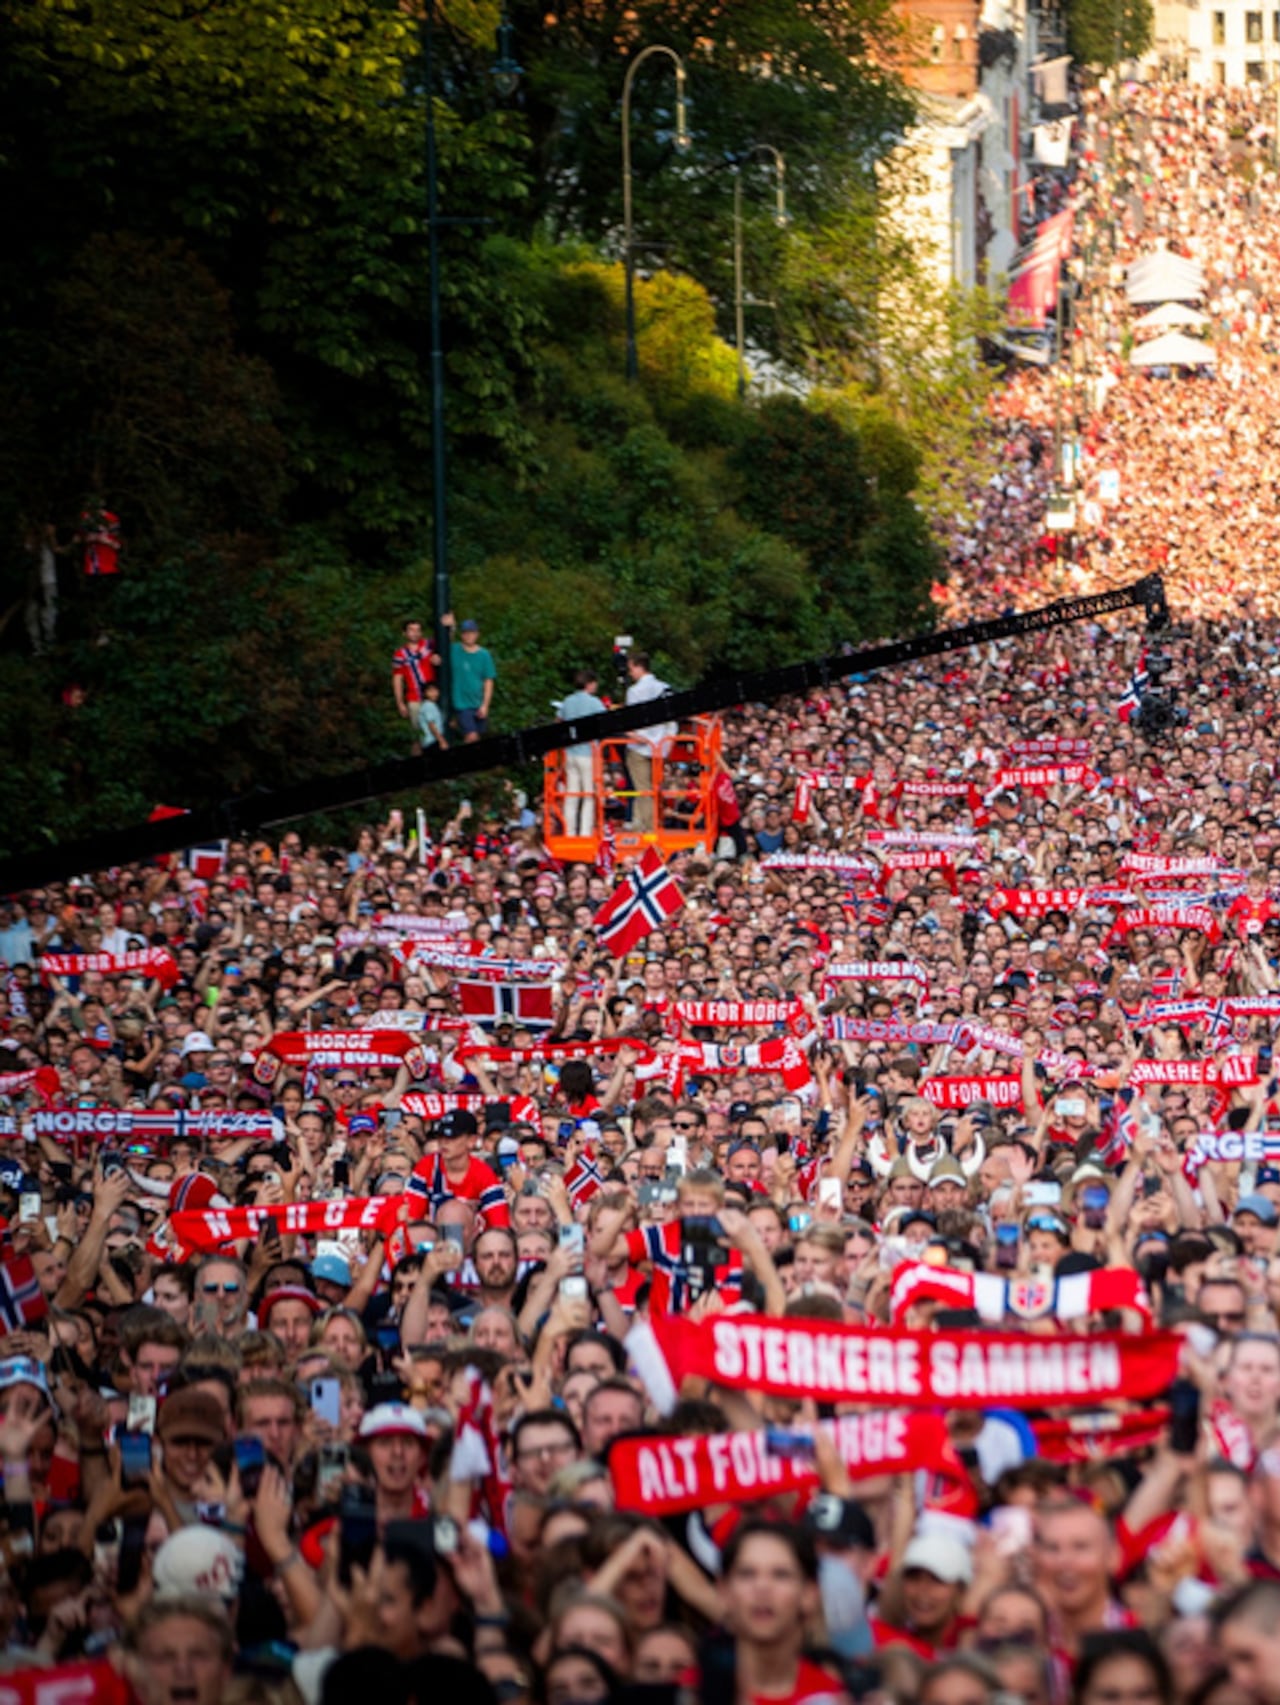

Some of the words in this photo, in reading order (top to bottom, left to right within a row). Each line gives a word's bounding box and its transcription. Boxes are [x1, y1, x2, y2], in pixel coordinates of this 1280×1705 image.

[902, 783, 967, 795] NORGE
[1019, 890, 1080, 904] NORG
[77, 953, 109, 971] FOR
[708, 1001, 739, 1021] FOR
[847, 1021, 951, 1041] NORGE
[305, 1034, 373, 1050] NORGE
[1221, 1057, 1251, 1085] ALT
[948, 1080, 982, 1104] FOR
[35, 1111, 134, 1133] NORGE
[714, 1320, 921, 1396] STERKERE
[929, 1341, 1122, 1397] SAMMEN
[637, 1438, 698, 1502] ALT
